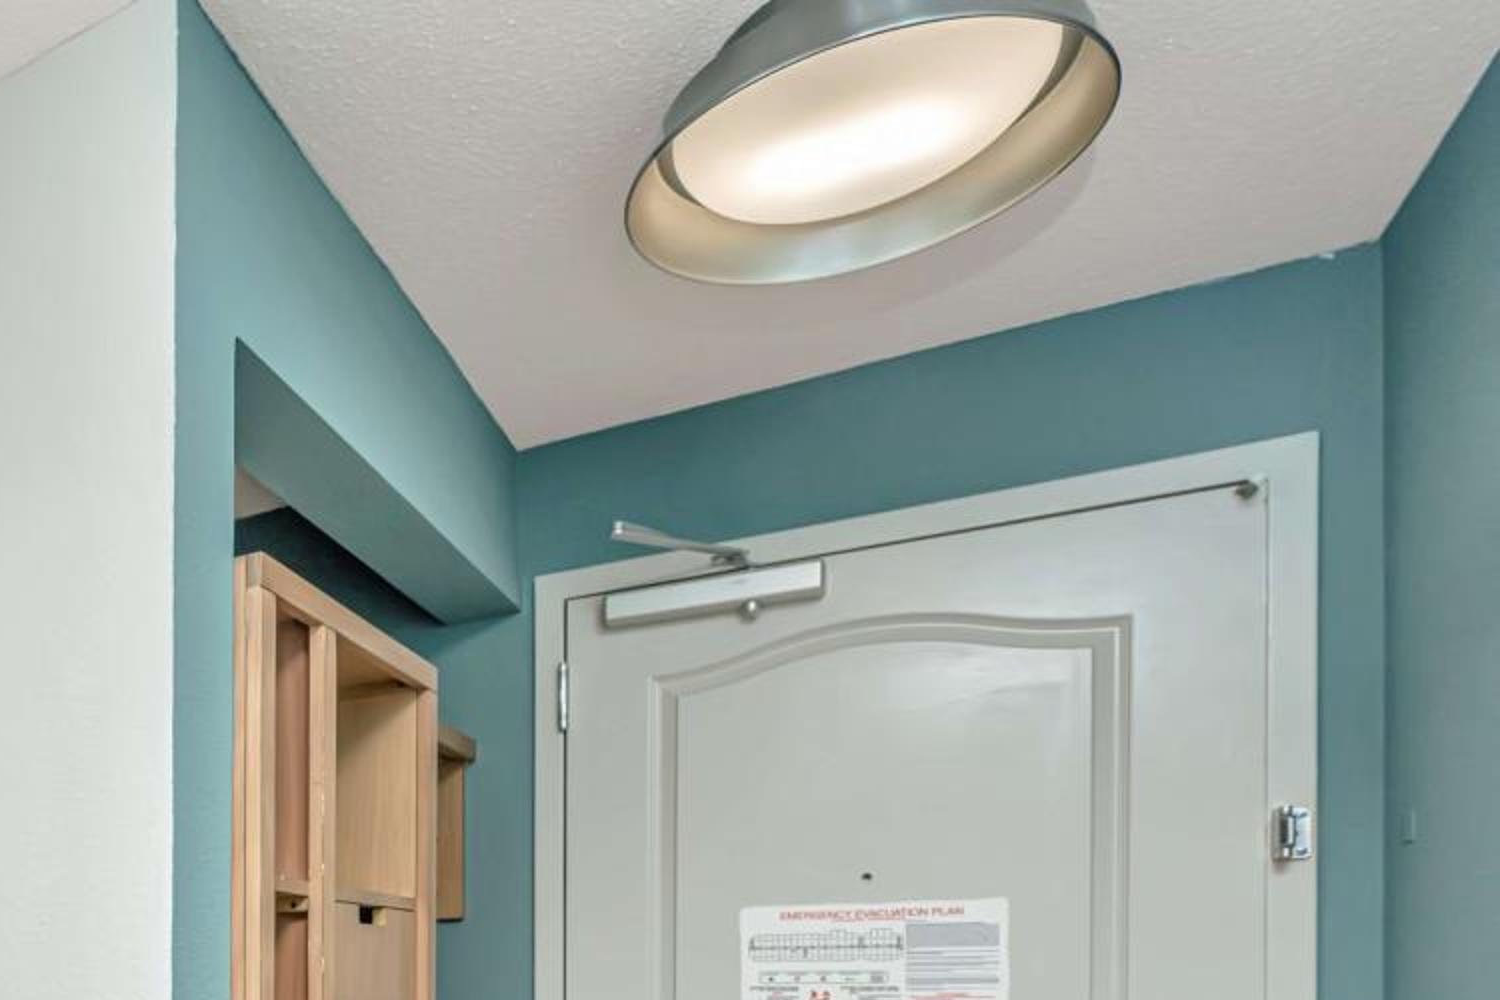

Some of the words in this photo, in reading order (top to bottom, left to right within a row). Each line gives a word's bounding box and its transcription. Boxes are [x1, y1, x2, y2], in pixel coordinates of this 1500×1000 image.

[779, 910, 853, 922] EMERGENCY
[854, 907, 929, 921] EVACUATION
[931, 905, 965, 917] PLAN
